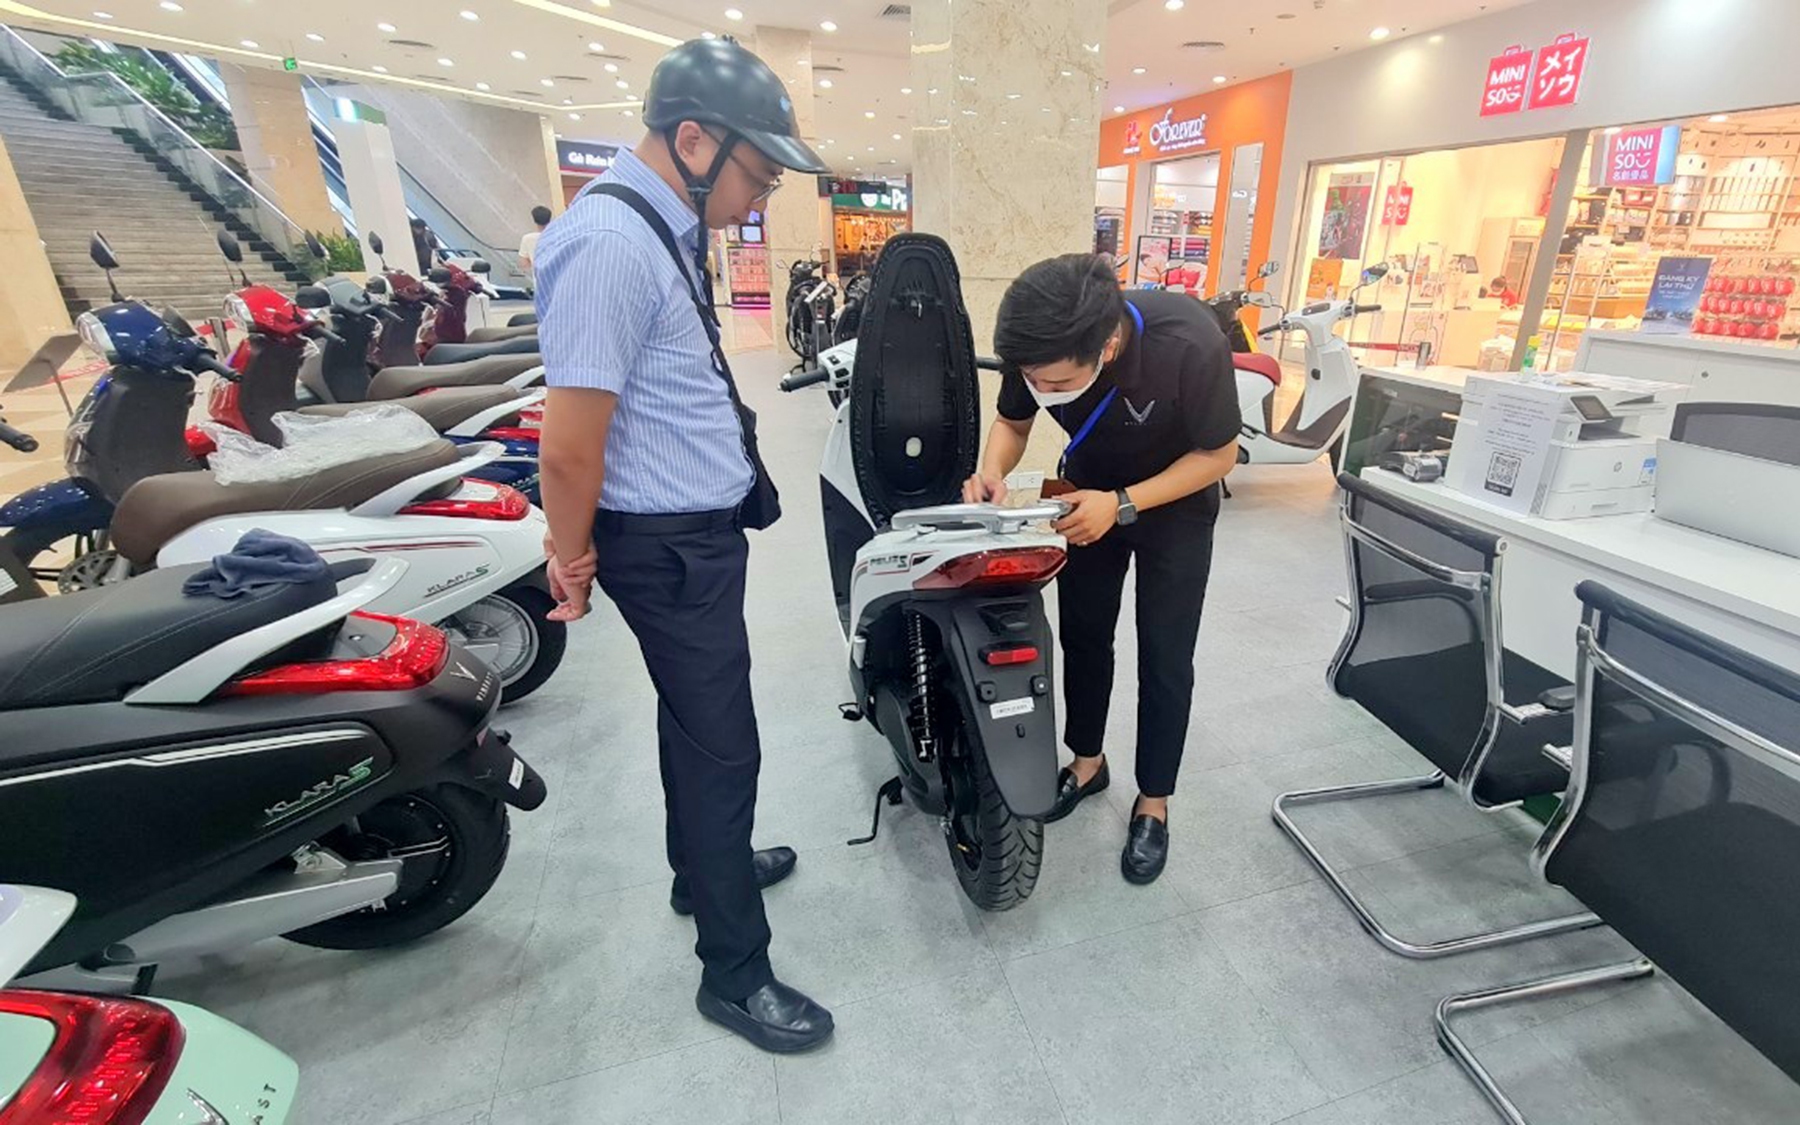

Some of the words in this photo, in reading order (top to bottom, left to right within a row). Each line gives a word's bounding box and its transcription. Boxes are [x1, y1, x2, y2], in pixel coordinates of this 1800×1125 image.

[1540, 46, 1582, 77] メイ
[1490, 64, 1526, 85] MINI
[1539, 74, 1576, 100] ソウ
[1615, 134, 1655, 152] MINI
